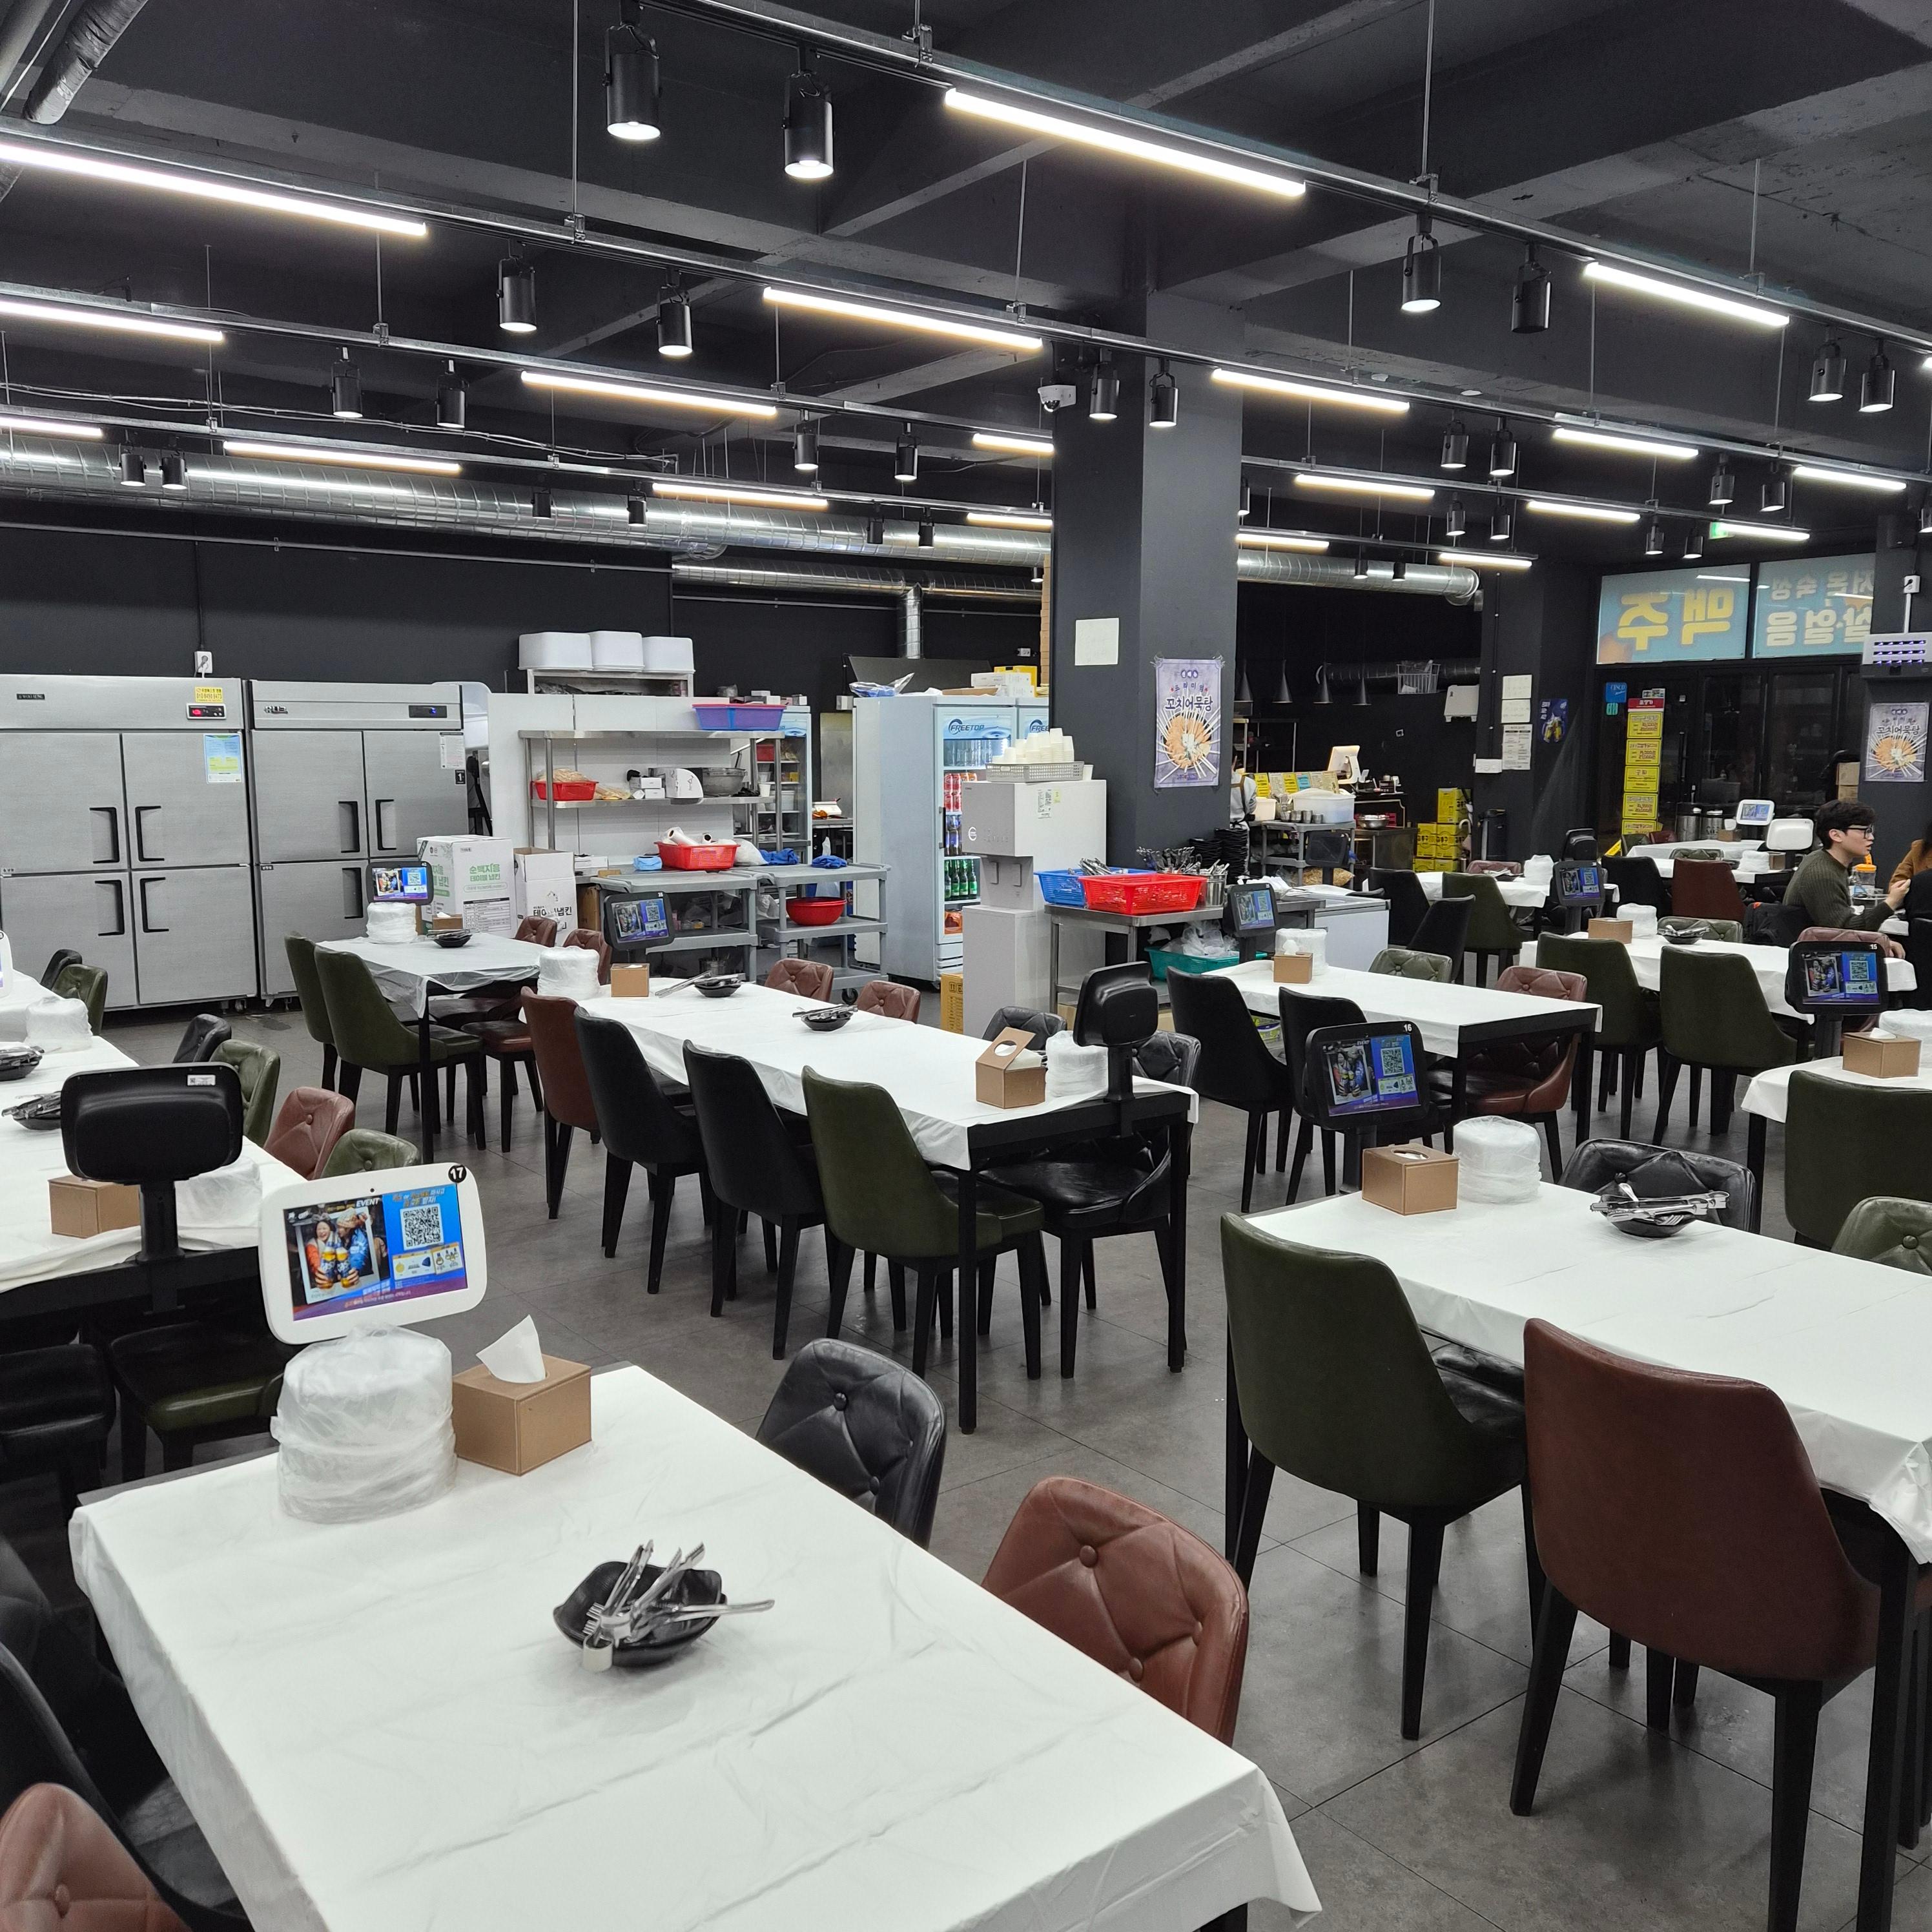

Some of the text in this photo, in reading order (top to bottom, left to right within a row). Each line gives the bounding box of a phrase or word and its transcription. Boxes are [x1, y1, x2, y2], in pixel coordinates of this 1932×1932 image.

[1165, 695, 1213, 712] 꼬치어묵탕
[950, 724, 985, 733] FREETOP
[557, 906, 572, 916] 냅킨
[1403, 1023, 1412, 1032] 16
[450, 1166, 464, 1180] 17
[356, 1197, 381, 1208] EVENT
